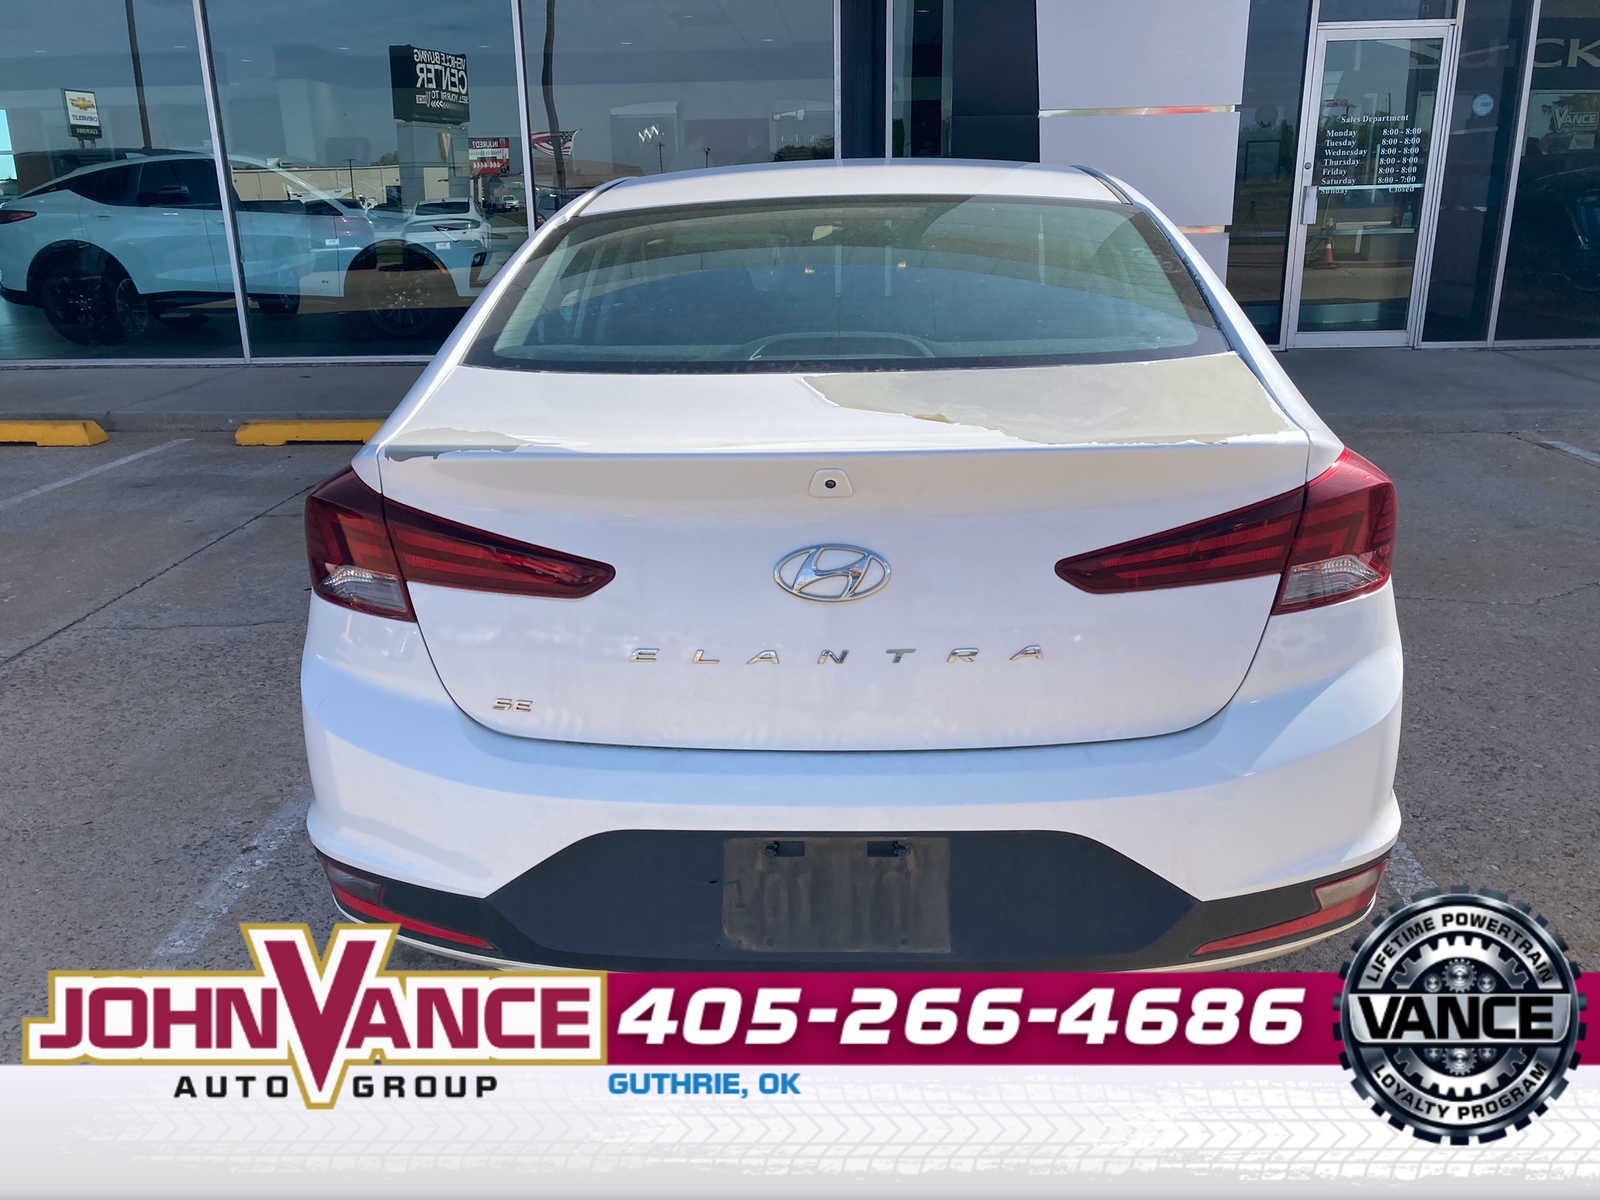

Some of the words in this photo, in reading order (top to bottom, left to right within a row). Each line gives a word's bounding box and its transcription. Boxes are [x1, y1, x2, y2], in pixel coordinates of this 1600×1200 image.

[1341, 115, 1361, 124] Sales
[1363, 114, 1409, 125] Department
[1326, 129, 1358, 138] Monday
[1382, 128, 1399, 136] 8:00
[1326, 138, 1356, 147] Tuesday
[1325, 148, 1367, 157] Wednesday
[1380, 147, 1397, 155] 8:00
[1324, 158, 1360, 167] Thursday
[1379, 157, 1396, 165] 8:00
[1322, 168, 1347, 176] Friday
[1321, 177, 1356, 185] Saturday
[1377, 176, 1394, 184] 8:00
[1400, 175, 1416, 183] 7:00
[630, 643, 1045, 665] ELANTRA
[492, 697, 534, 713] SE
